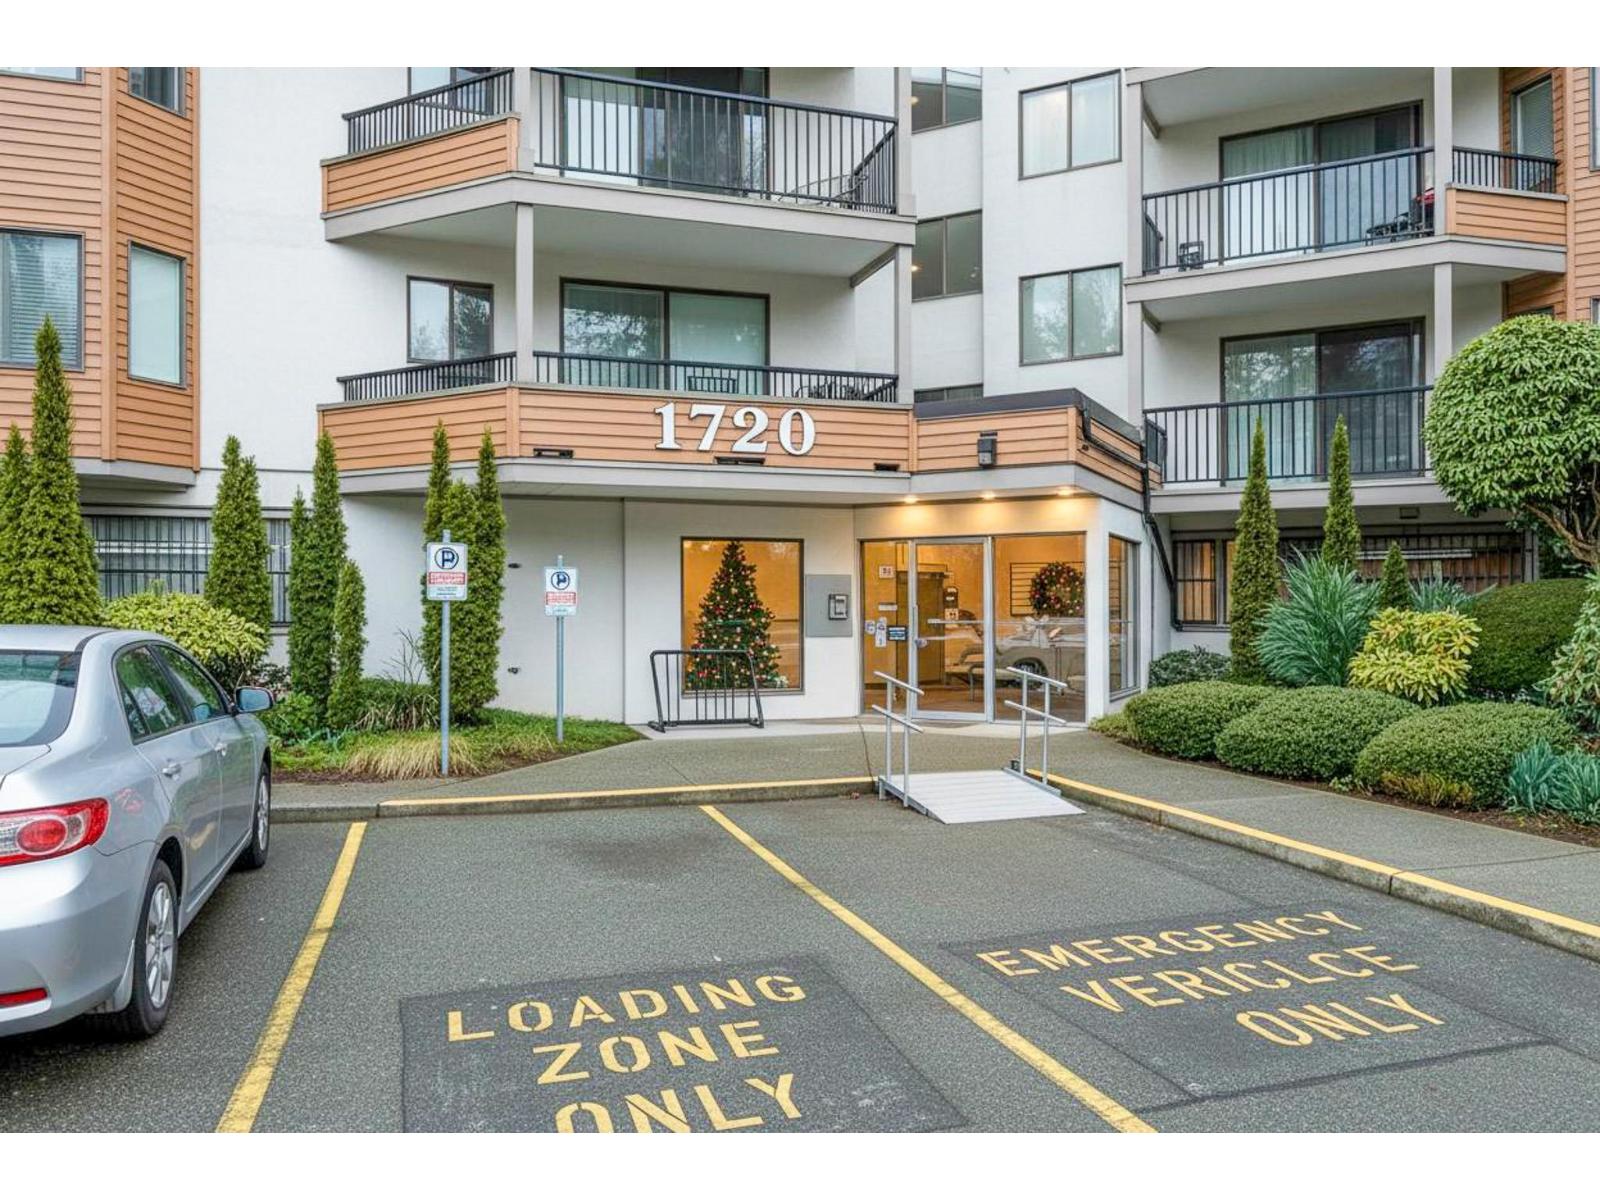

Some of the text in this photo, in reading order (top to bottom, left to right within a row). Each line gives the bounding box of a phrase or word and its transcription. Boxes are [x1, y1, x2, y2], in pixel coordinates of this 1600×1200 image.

[655, 402, 816, 456] 1720
[976, 911, 1363, 977] EMERGENCY
[447, 975, 807, 1042] LOADING
[1236, 994, 1446, 1047] ONLY
[532, 1020, 780, 1085] ZONE
[553, 1073, 803, 1133] ONLY
